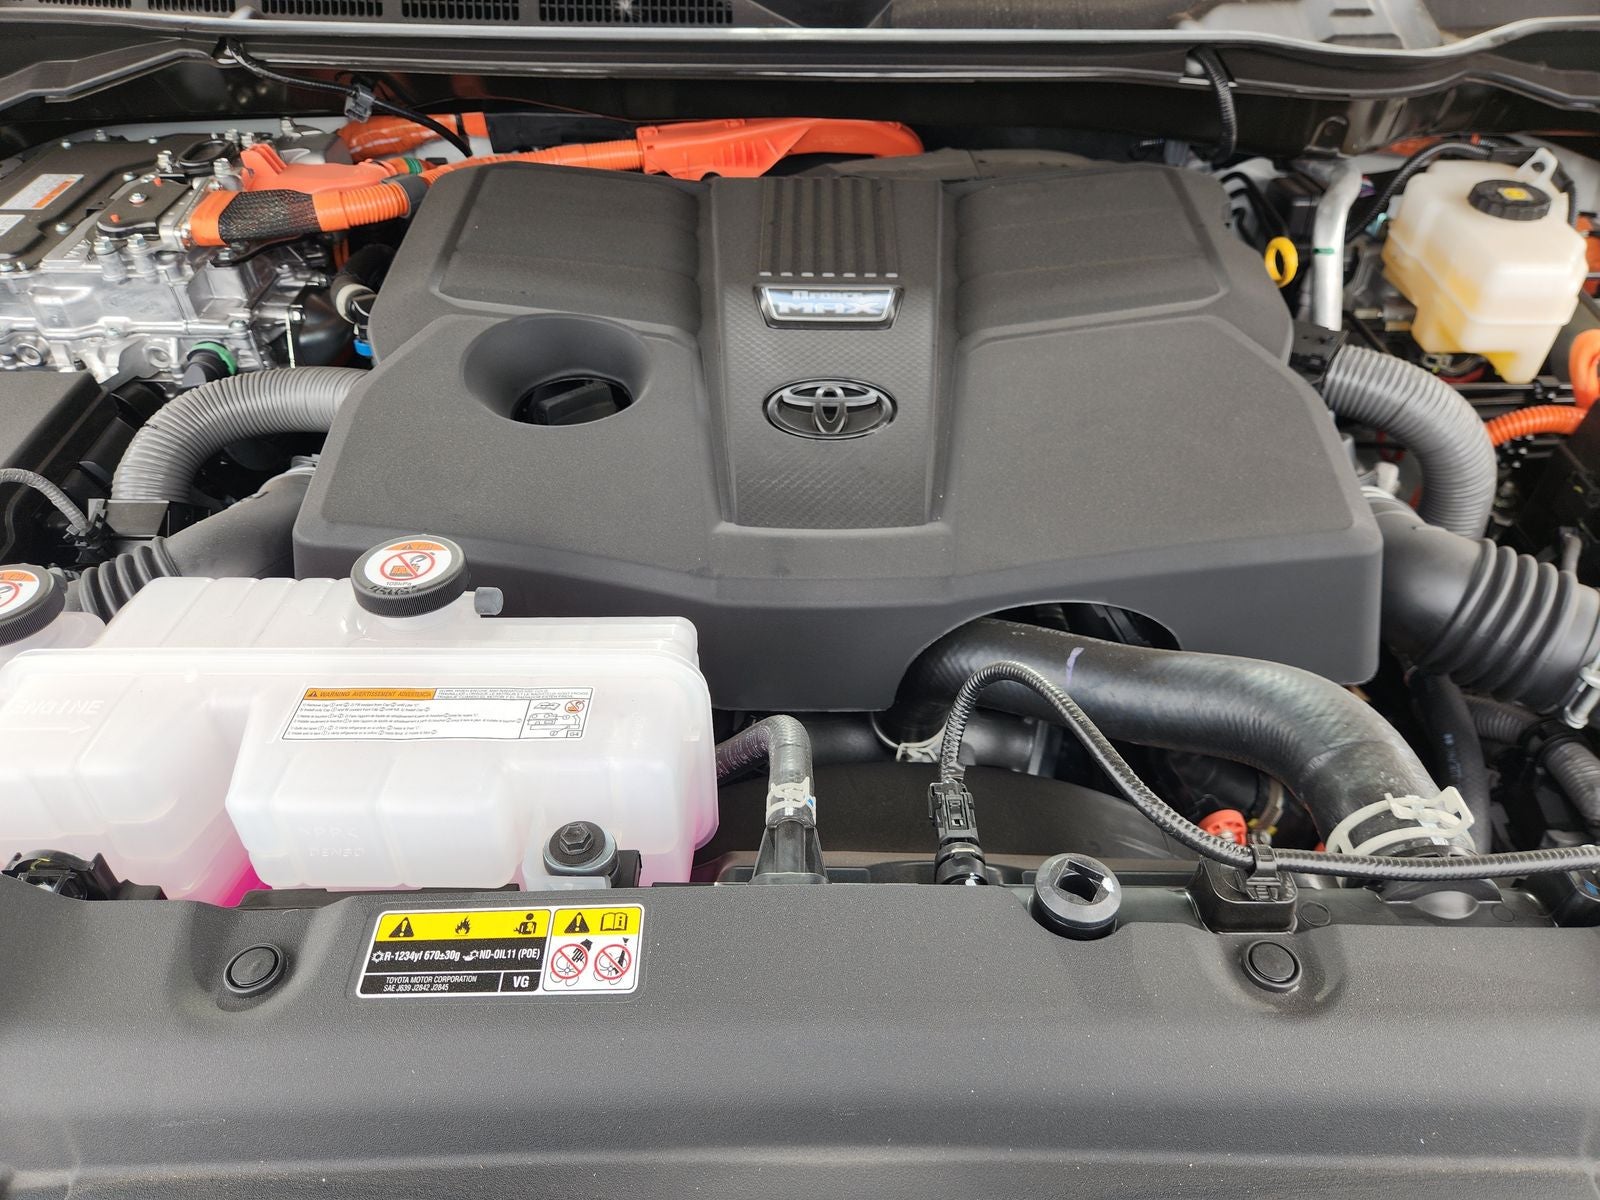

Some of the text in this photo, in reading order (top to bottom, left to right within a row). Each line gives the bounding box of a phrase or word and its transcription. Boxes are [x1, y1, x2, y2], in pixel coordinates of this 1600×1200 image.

[384, 948, 541, 963] R-1234yf 670±30g ND-OIL11 (POE)
[386, 975, 478, 984] TOYOTA MOTOR CORPORATION
[513, 975, 530, 988] VG
[383, 984, 396, 992] SAE
[396, 984, 412, 992] J639
[431, 983, 449, 991] J2845
